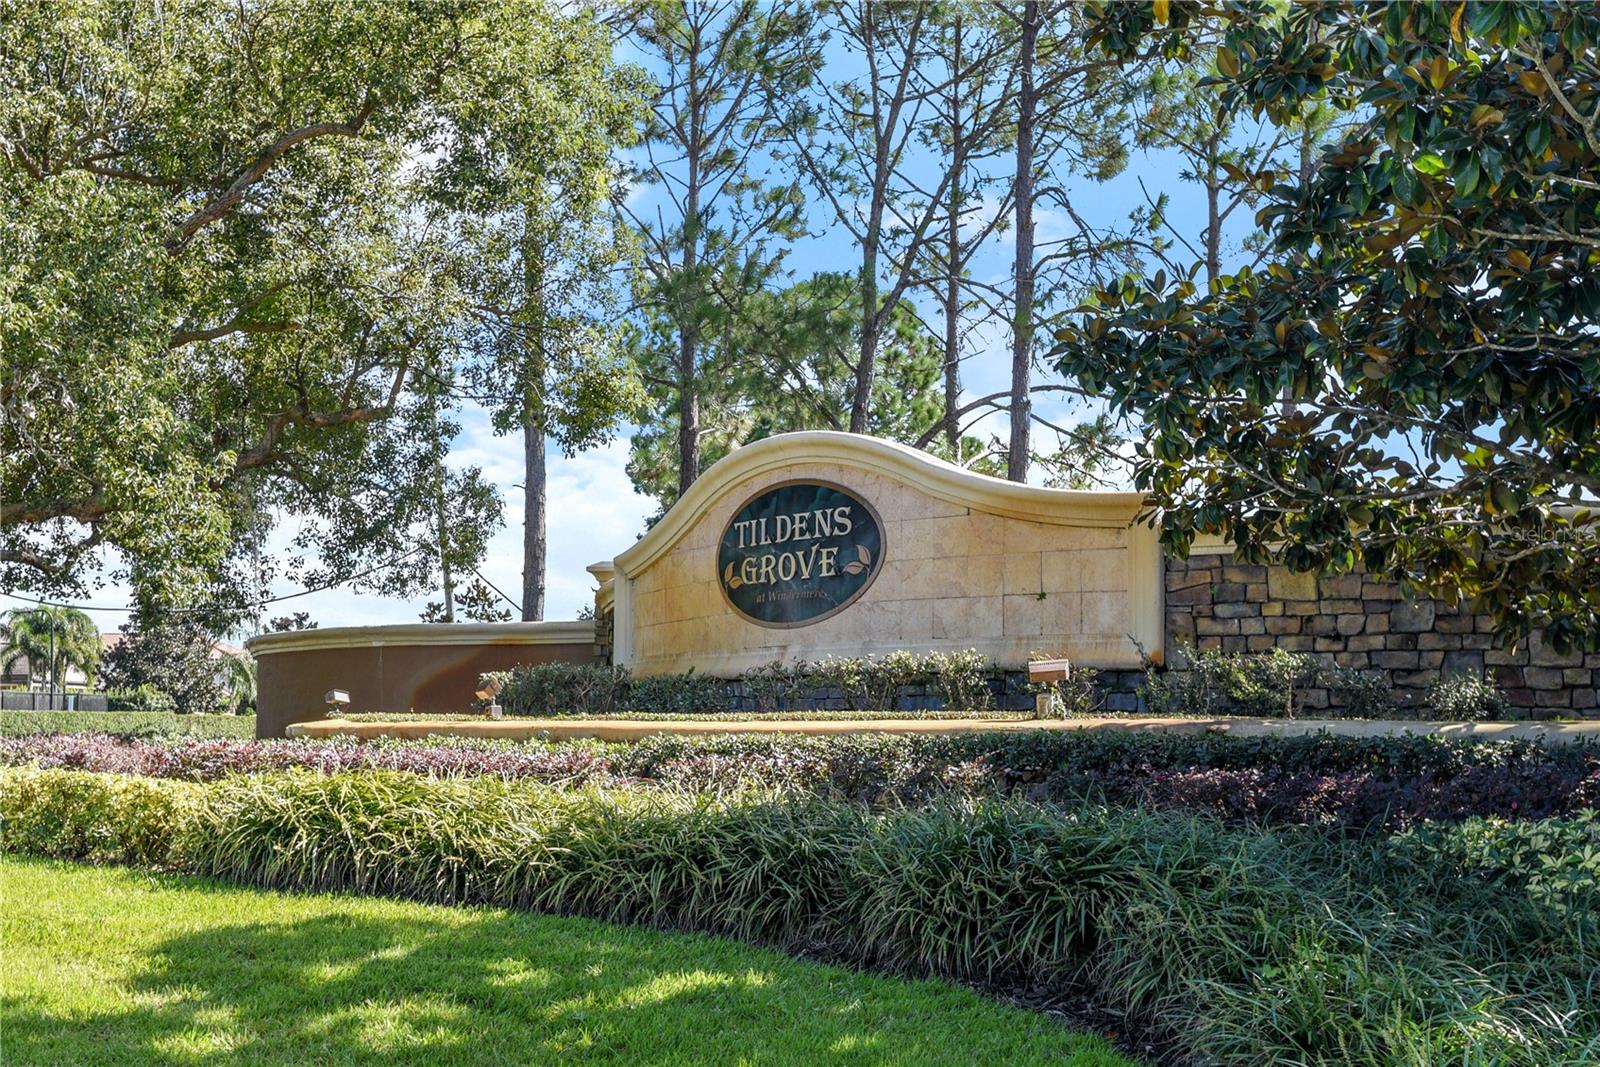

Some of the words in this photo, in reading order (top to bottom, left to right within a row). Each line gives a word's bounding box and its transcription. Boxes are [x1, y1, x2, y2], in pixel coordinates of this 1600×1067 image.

[734, 506, 853, 549] TILDENS
[740, 542, 839, 585] GROVE
[756, 591, 766, 603] at
